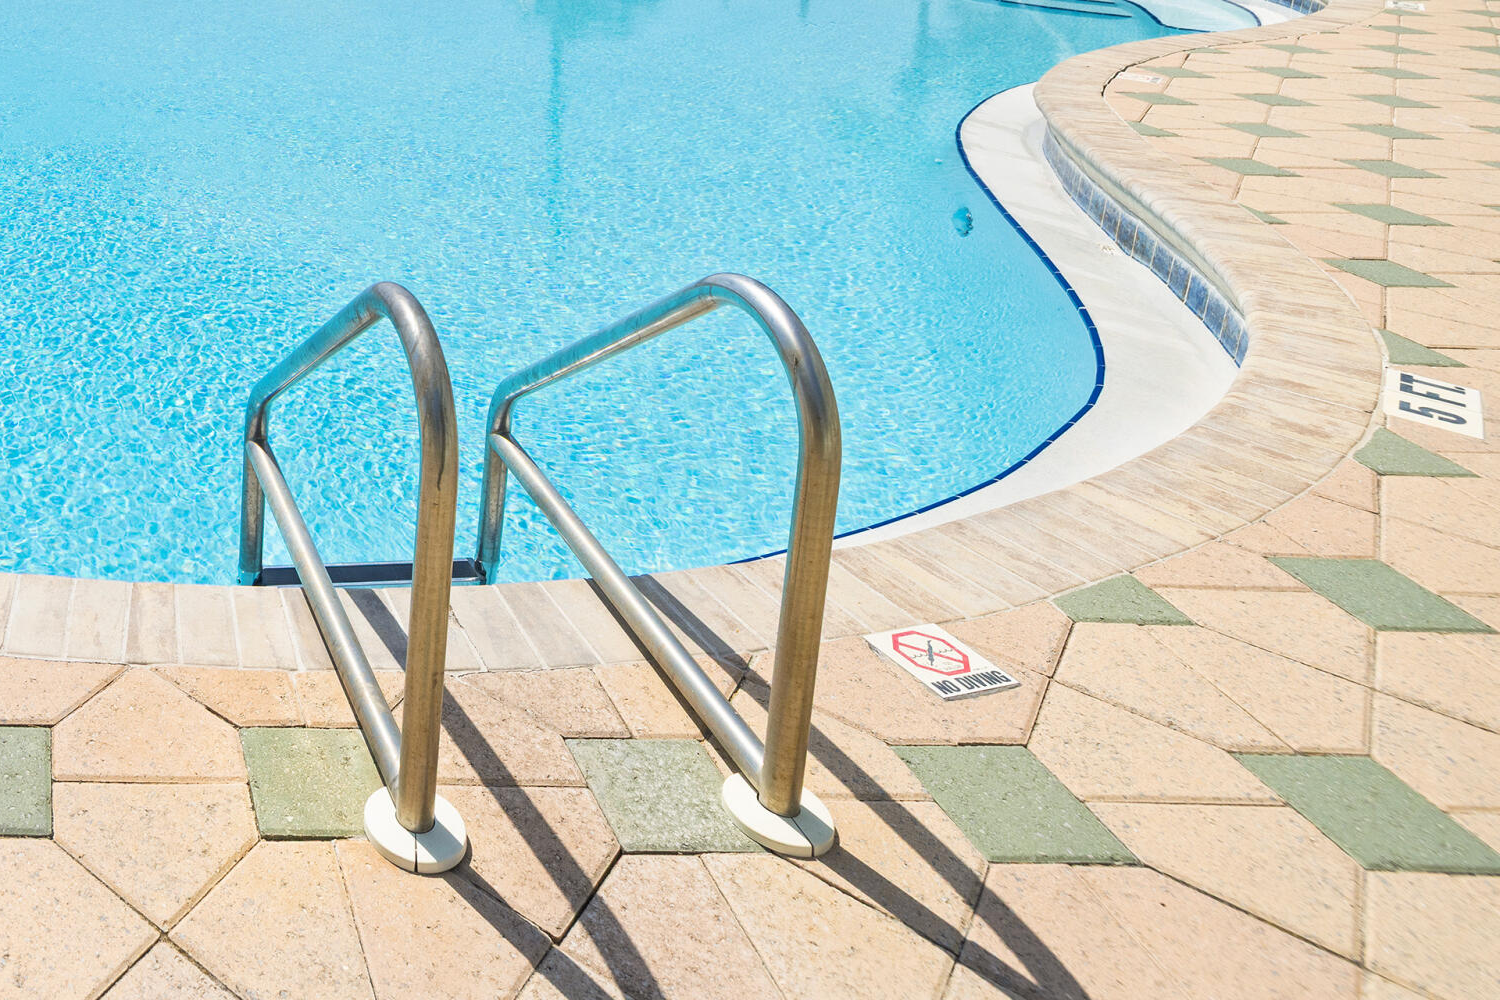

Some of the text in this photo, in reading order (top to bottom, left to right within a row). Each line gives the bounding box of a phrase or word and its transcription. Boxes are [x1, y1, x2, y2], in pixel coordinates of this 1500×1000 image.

[1399, 400, 1467, 425] 5
[931, 670, 1012, 695] NO DIVING
